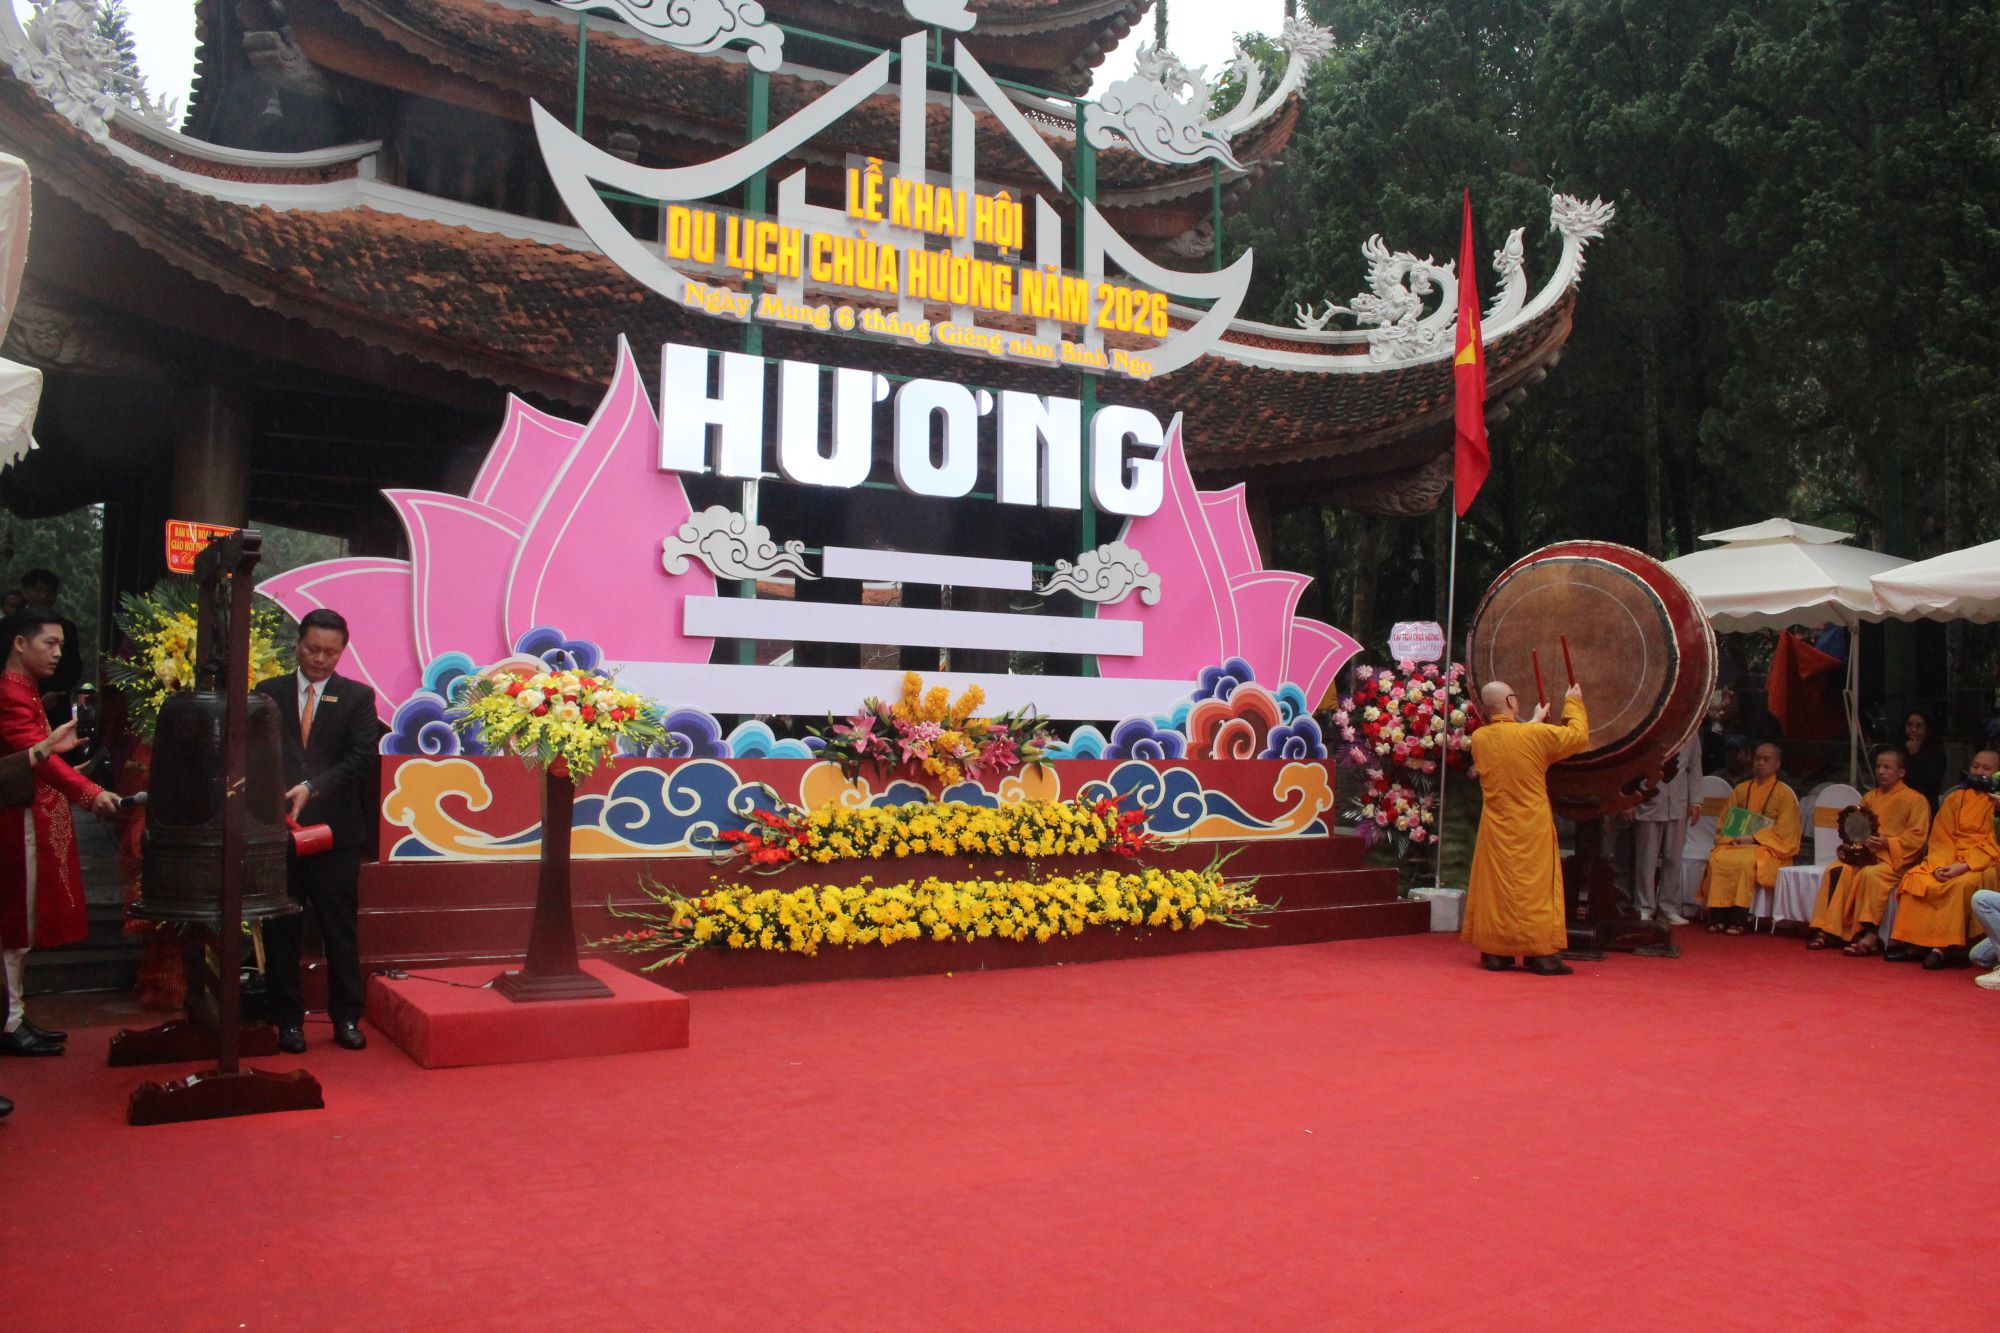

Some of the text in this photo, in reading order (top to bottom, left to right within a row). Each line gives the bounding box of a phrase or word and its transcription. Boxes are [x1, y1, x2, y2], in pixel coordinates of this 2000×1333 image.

[846, 156, 1023, 254] LỄ KHAI HỘI
[667, 204, 1168, 338] DU LỊCH CHÙA HƯƠNG NĂM 2026
[684, 282, 751, 319] Ngày
[837, 306, 854, 330] 6
[862, 309, 931, 343] tháng
[937, 322, 1003, 354] Giêng
[1009, 337, 1054, 360] năm
[1061, 341, 1108, 368] Bính
[1114, 351, 1153, 379] Ngọ
[659, 343, 1164, 516] HƯƠNG
[170, 539, 184, 550] GIÁO
[184, 540, 195, 552] HỘI
[175, 527, 185, 537] BAN
